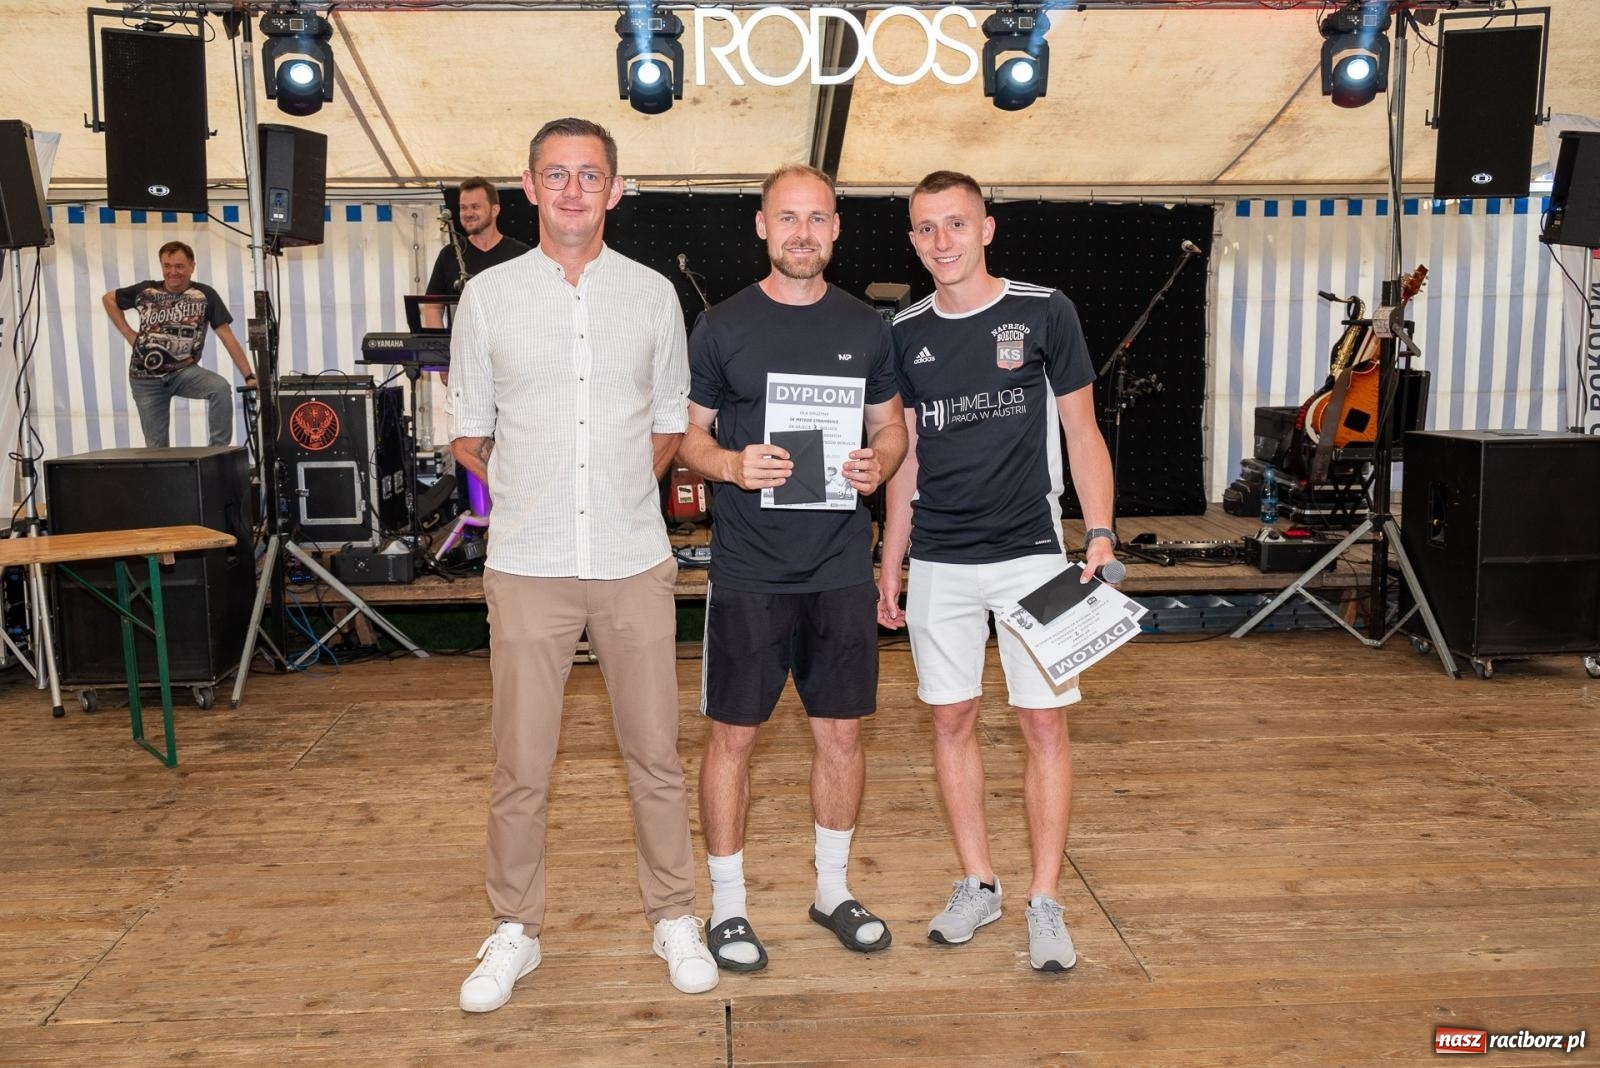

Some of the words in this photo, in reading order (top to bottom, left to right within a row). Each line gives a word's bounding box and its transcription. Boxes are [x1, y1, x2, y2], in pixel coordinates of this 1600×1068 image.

[694, 6, 979, 86] RODOS
[377, 340, 404, 348] YAMAHA
[913, 355, 936, 365] adidas
[1000, 348, 1021, 361] KS
[776, 385, 855, 405] DYPLOM
[951, 412, 978, 425] PRACA
[979, 411, 990, 419] W
[992, 405, 1027, 418] AUSTRII
[1055, 621, 1127, 675] DYPLOM
